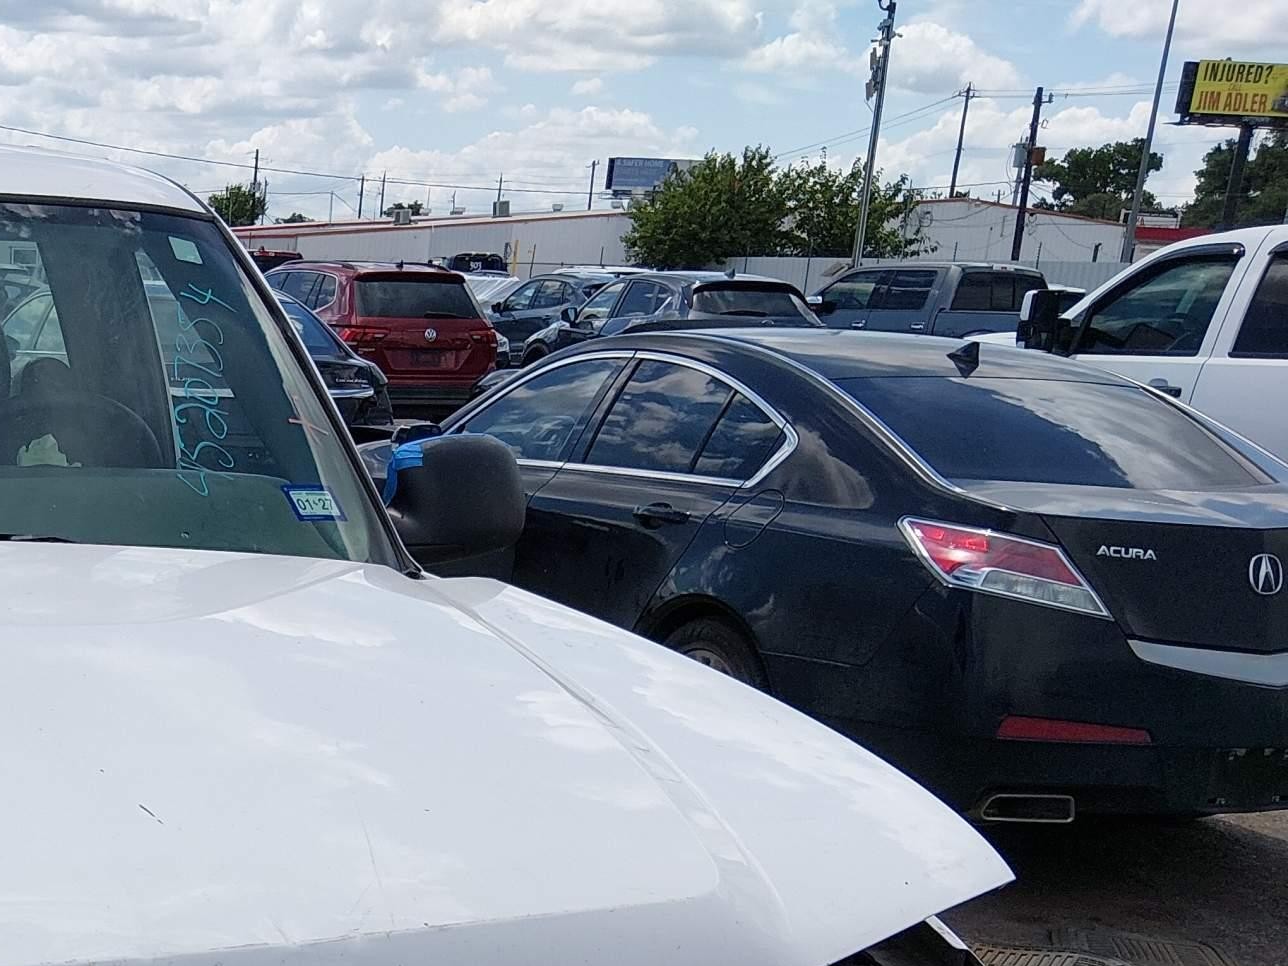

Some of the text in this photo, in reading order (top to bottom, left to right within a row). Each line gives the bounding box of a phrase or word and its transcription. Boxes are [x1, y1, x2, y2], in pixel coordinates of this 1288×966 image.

[1203, 62, 1274, 84] INJURED?
[1196, 90, 1268, 113] JIM ADLER
[174, 283, 238, 497] 45207354
[296, 498, 333, 511] 01 27
[1096, 545, 1157, 561] ACURA
